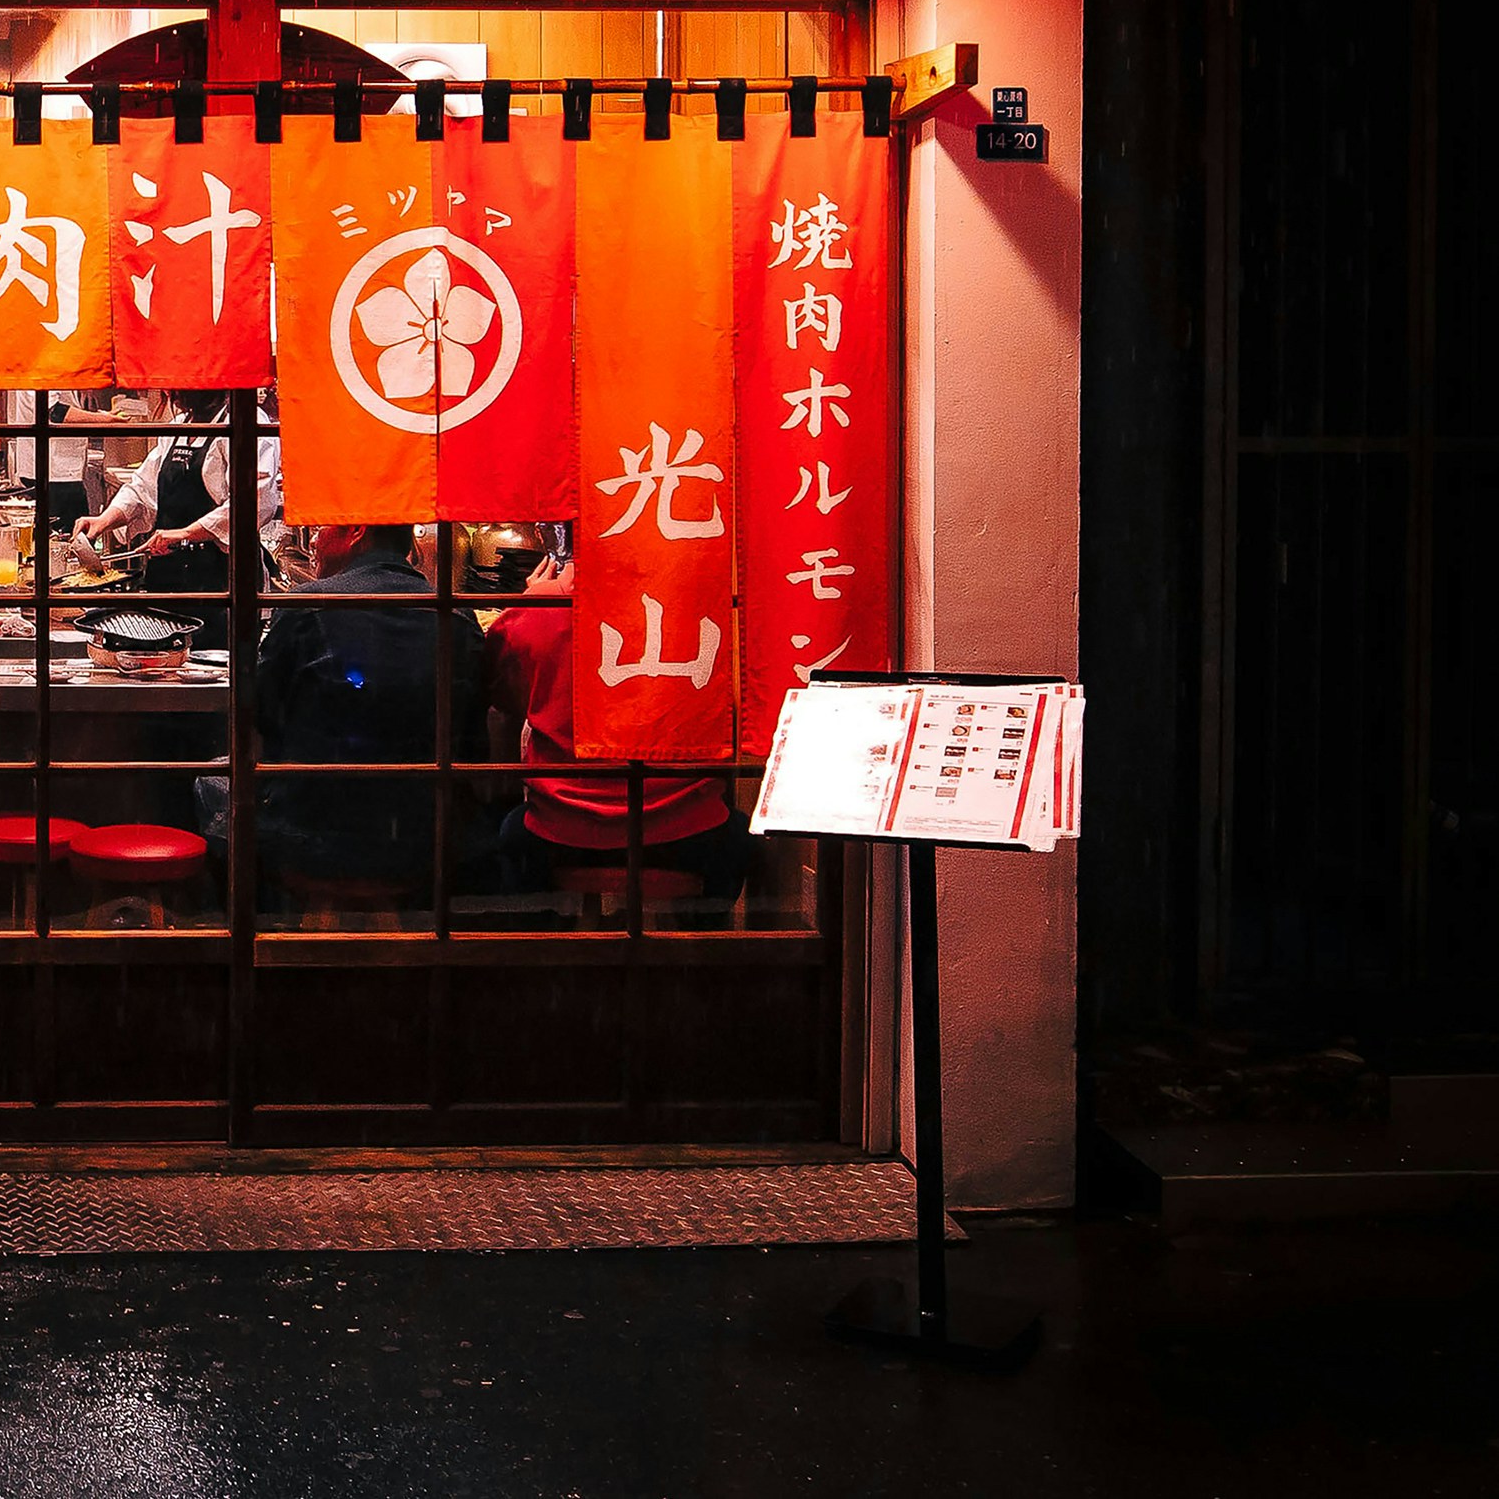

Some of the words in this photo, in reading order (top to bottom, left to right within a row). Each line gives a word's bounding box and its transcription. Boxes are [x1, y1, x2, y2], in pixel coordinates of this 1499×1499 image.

[987, 132, 1037, 150] 14-20
[997, 106, 1023, 118] 一丁目
[768, 191, 855, 683] 焼肉ホルモン
[595, 421, 725, 691] 光山
